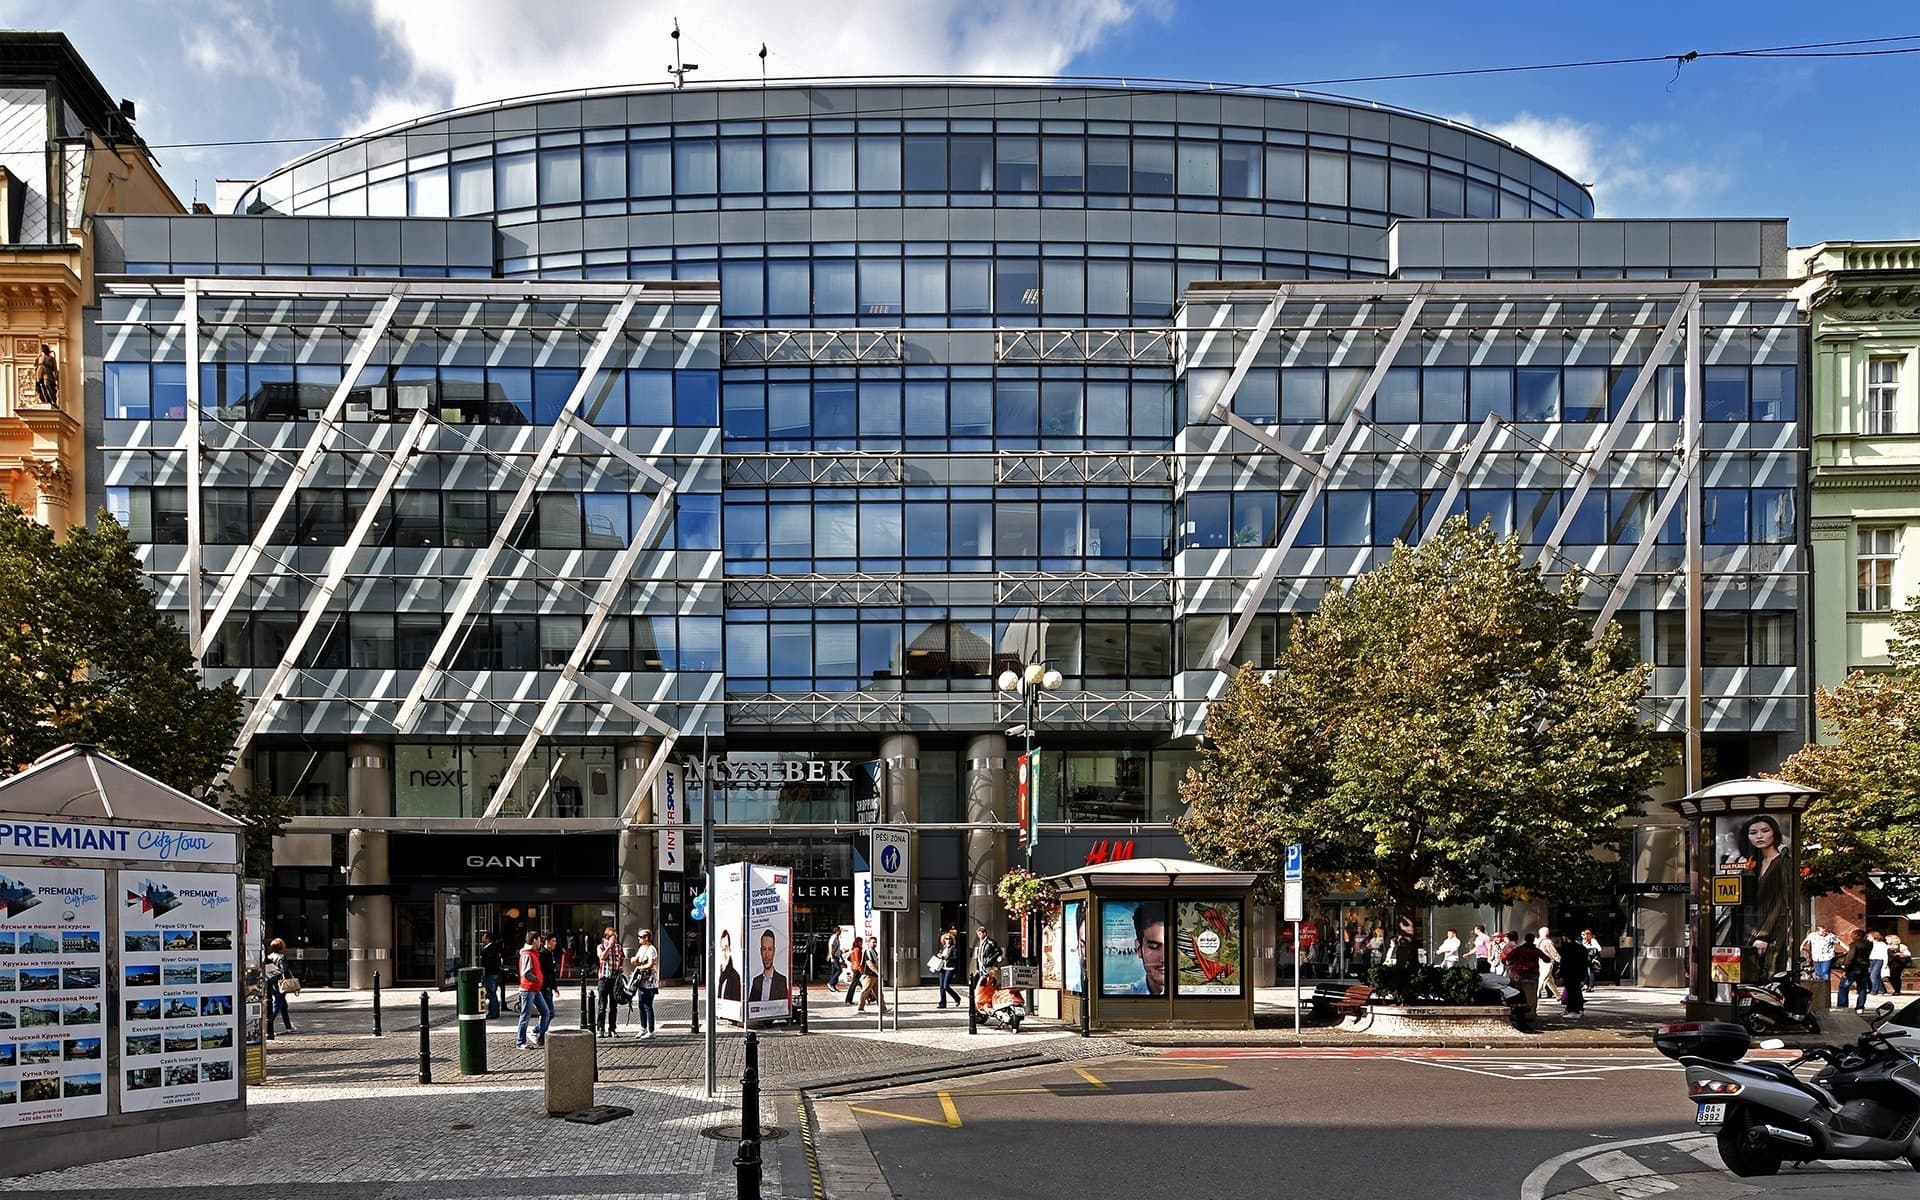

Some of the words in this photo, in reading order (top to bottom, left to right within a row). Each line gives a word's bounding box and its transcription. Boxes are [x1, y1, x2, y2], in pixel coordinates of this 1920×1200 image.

[410, 768, 469, 787] next
[0, 824, 130, 851] PREMIANT
[138, 831, 172, 859] City
[466, 856, 541, 868] GANT
[1288, 847, 1298, 868] P
[38, 887, 84, 896] PREMIANT
[179, 890, 218, 898] PREMIANT
[792, 886, 849, 897] LERIE
[1718, 885, 1737, 896] TAXI
[160, 1057, 177, 1065] Czech
[1698, 1113, 1720, 1121] 9992
